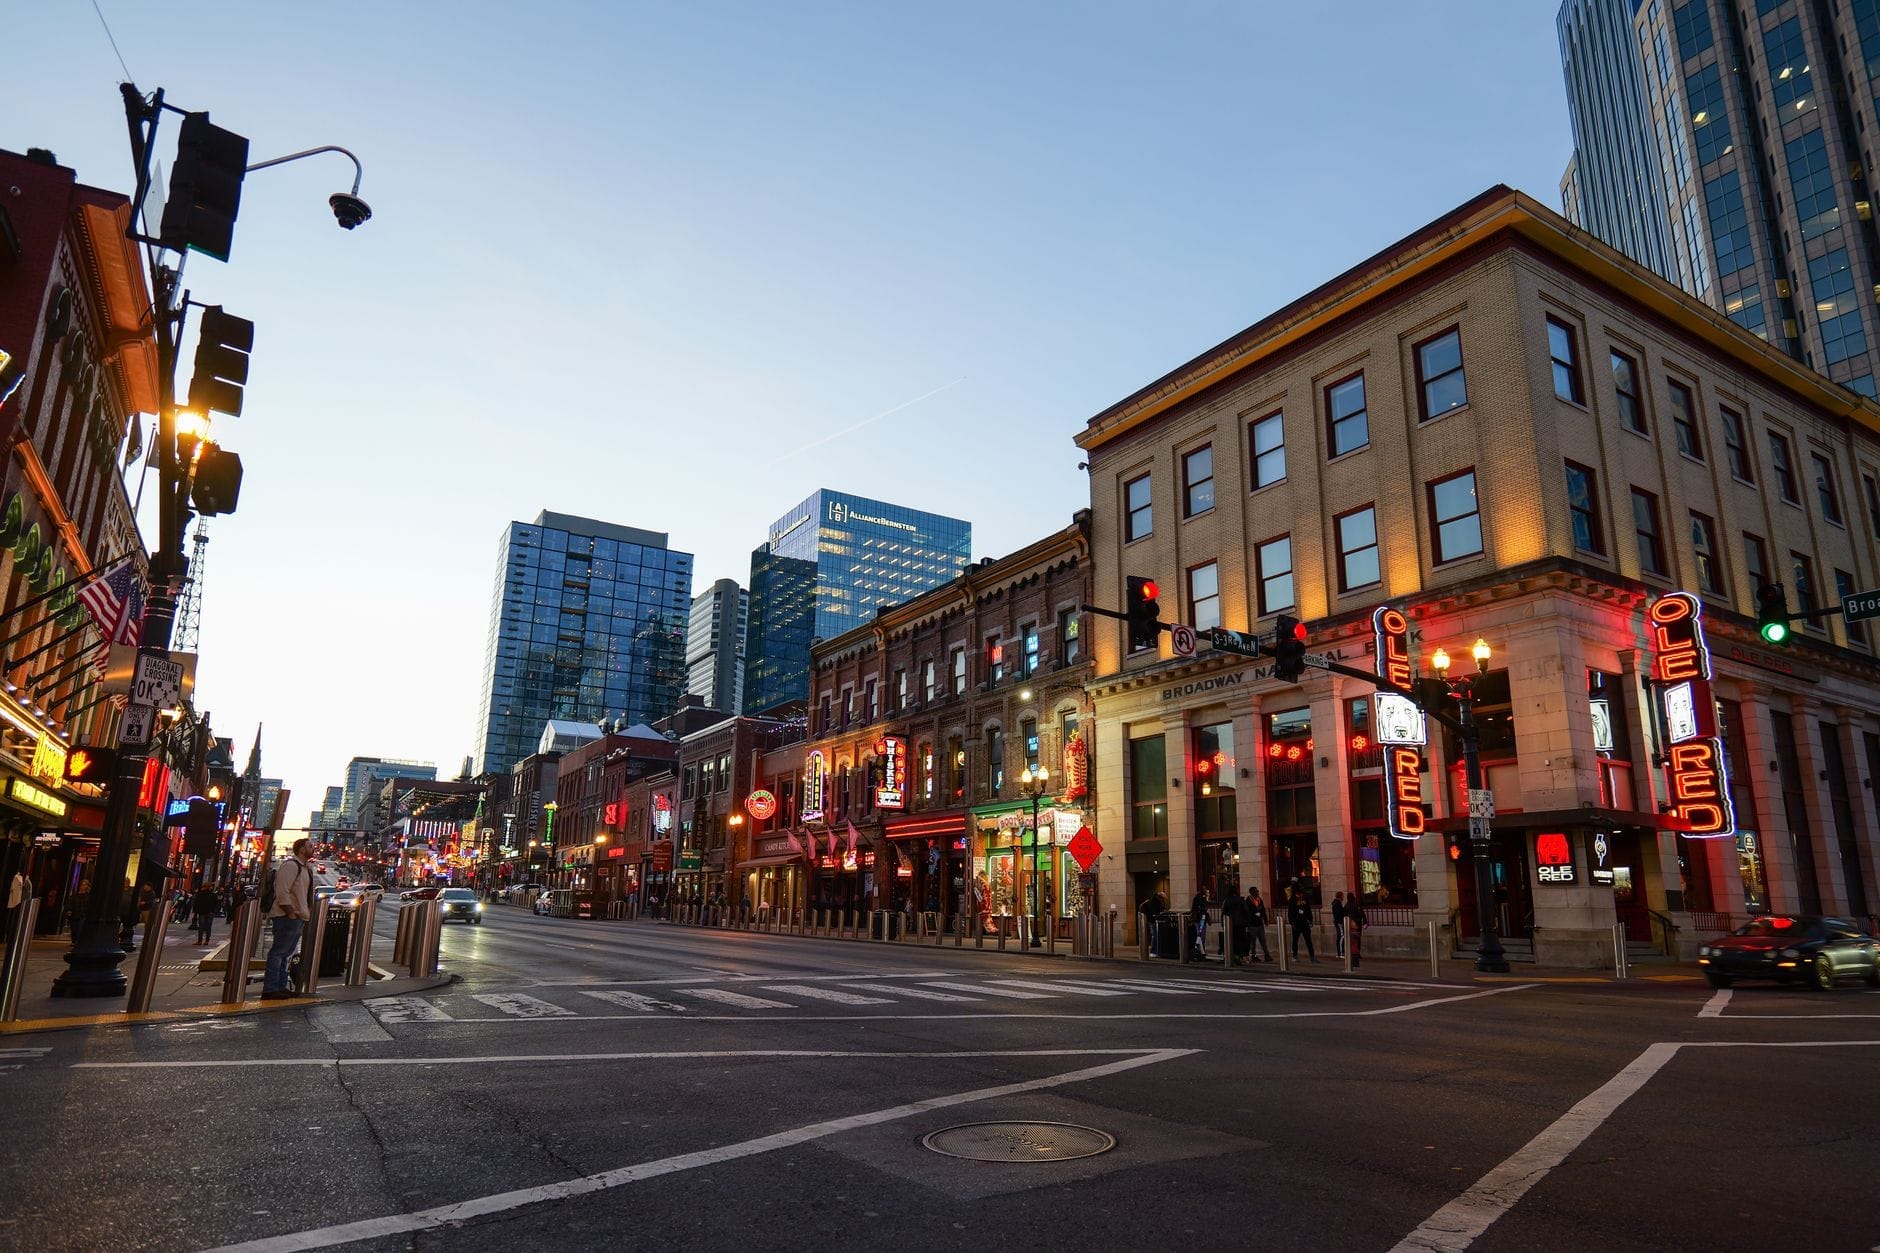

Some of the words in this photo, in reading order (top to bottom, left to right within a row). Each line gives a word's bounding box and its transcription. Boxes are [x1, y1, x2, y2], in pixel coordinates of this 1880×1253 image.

[1652, 597, 1698, 681] OLE
[1384, 610, 1412, 692] OLE
[144, 668, 177, 683] CROSSING
[145, 658, 178, 674] DIAGONAL
[137, 680, 155, 700] OK
[1162, 671, 1244, 700] BROADWAY
[1396, 749, 1425, 834] RED
[1672, 744, 1723, 832] RED
[1470, 802, 1481, 814] OK
[1537, 865, 1573, 874] OLE
[1539, 873, 1574, 882] RED
